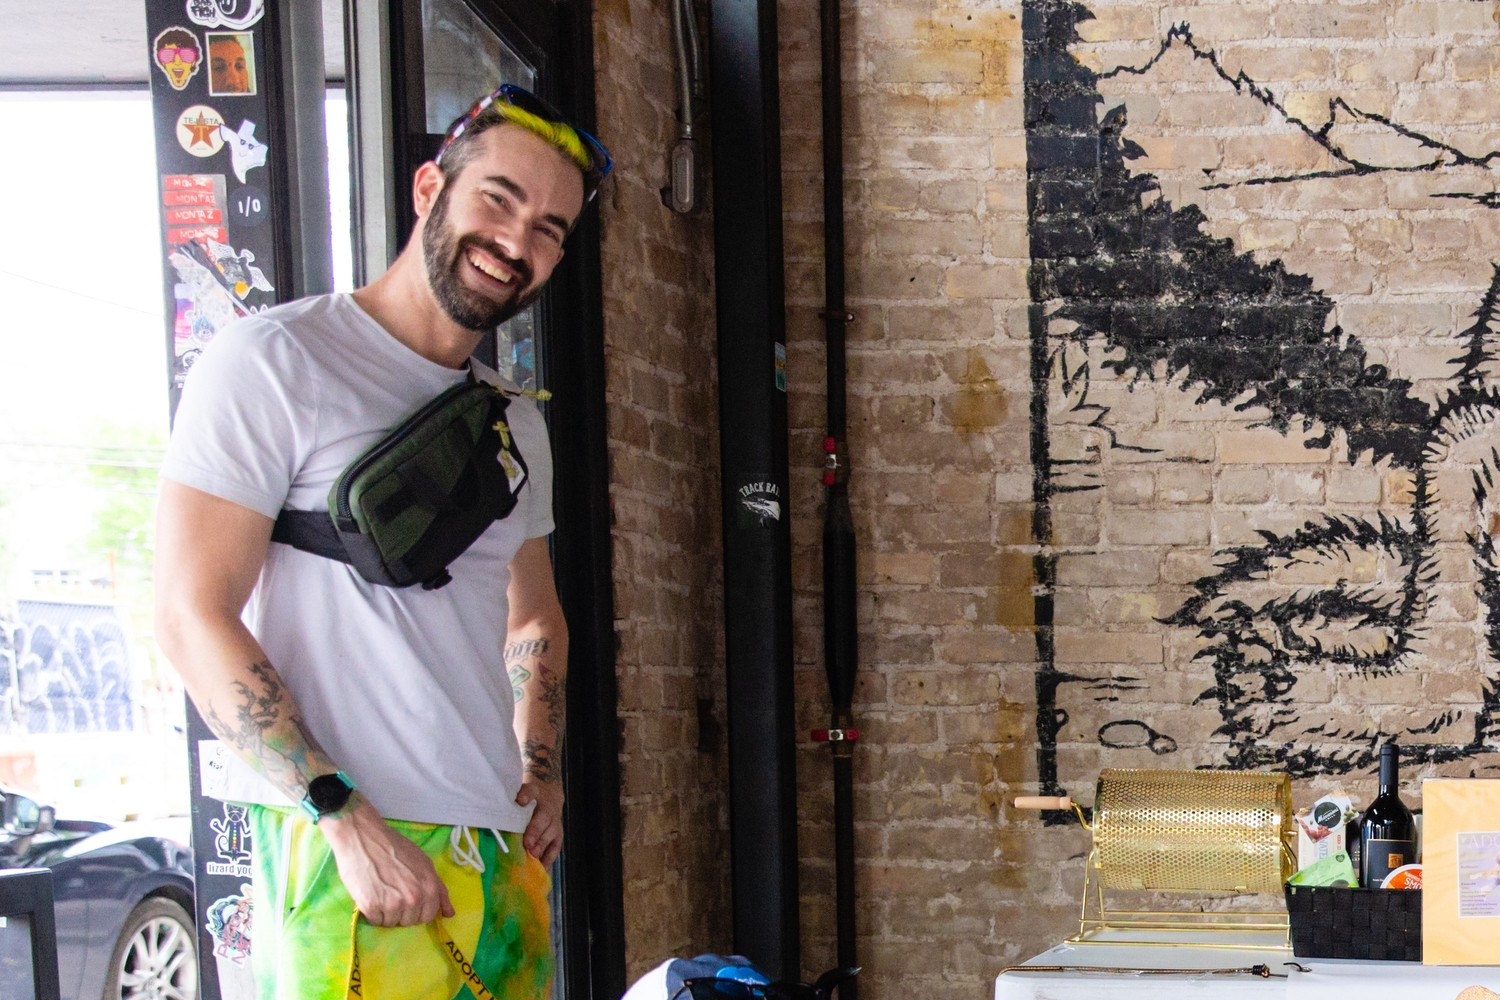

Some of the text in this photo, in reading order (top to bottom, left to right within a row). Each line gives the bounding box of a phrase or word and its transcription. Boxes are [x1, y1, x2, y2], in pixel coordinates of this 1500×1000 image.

[176, 210, 214, 220] MONTAZ
[738, 481, 764, 498] TRACK
[208, 864, 234, 873] lizard
[445, 940, 490, 996] ADOPT
